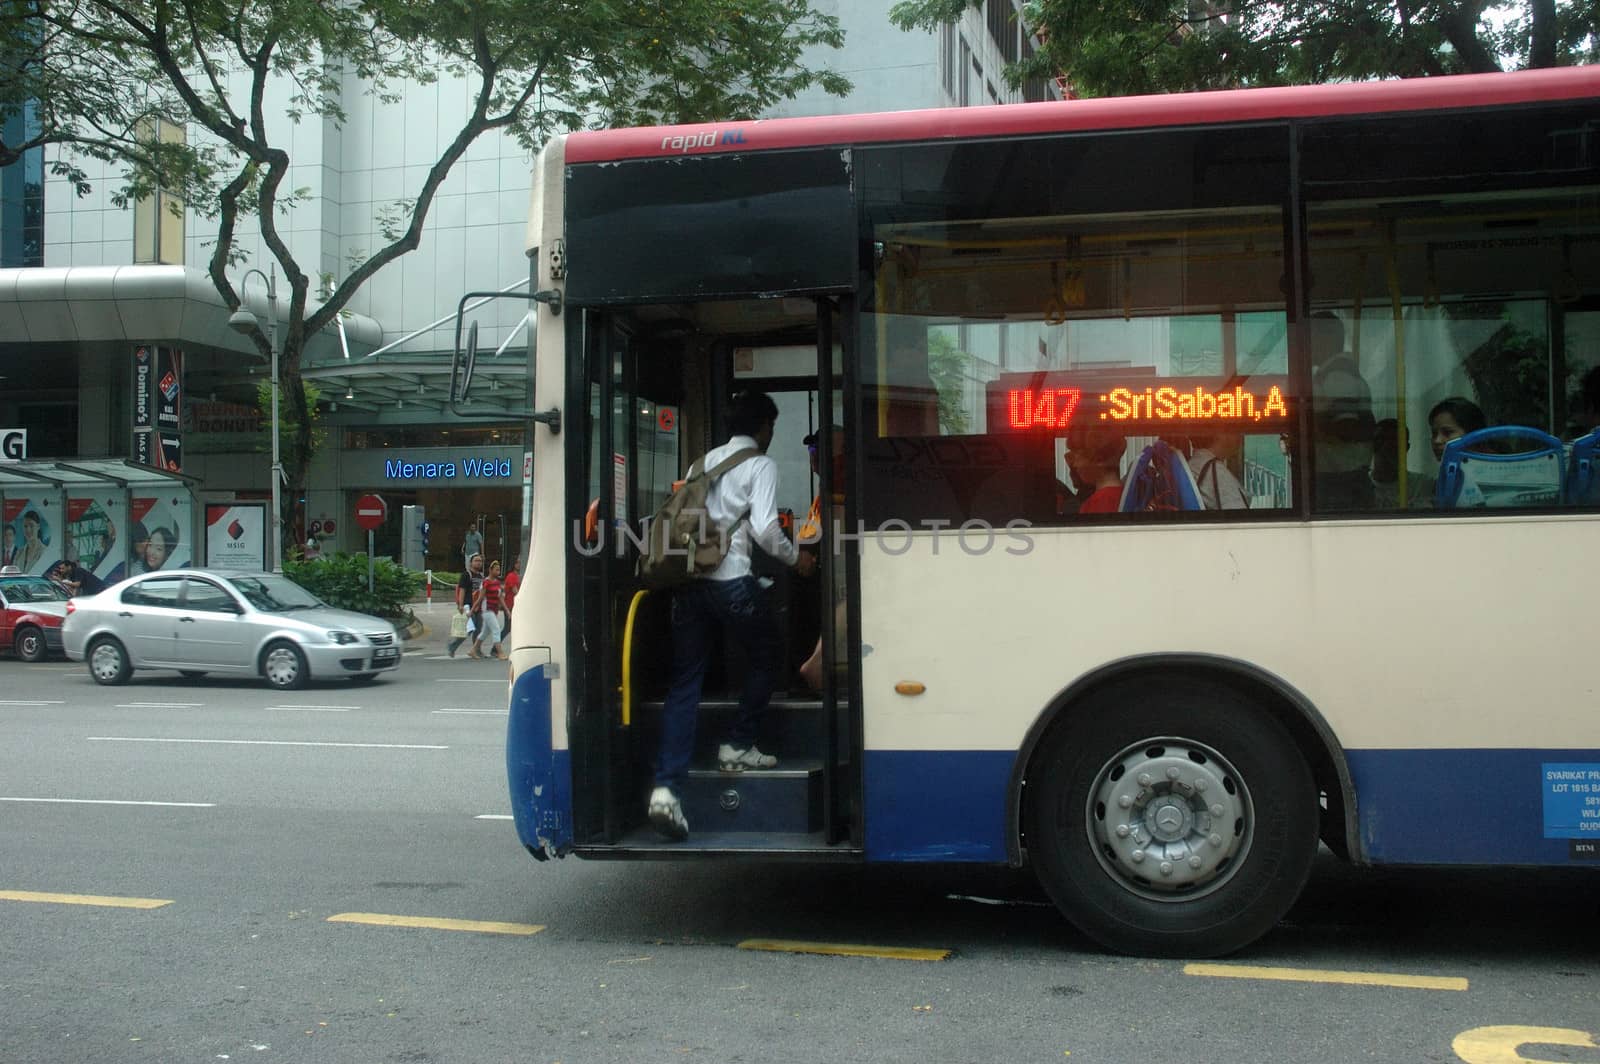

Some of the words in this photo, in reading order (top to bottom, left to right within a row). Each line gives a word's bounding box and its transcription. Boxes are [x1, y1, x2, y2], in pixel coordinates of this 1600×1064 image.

[661, 131, 717, 152] rapid
[722, 128, 748, 144] KL
[138, 365, 149, 423] Domino's
[1009, 389, 1080, 429] U47
[385, 460, 456, 478] Menara
[463, 458, 512, 478] Weld
[1546, 771, 1586, 780] SYARIKAT
[1552, 784, 1568, 792] LOT
